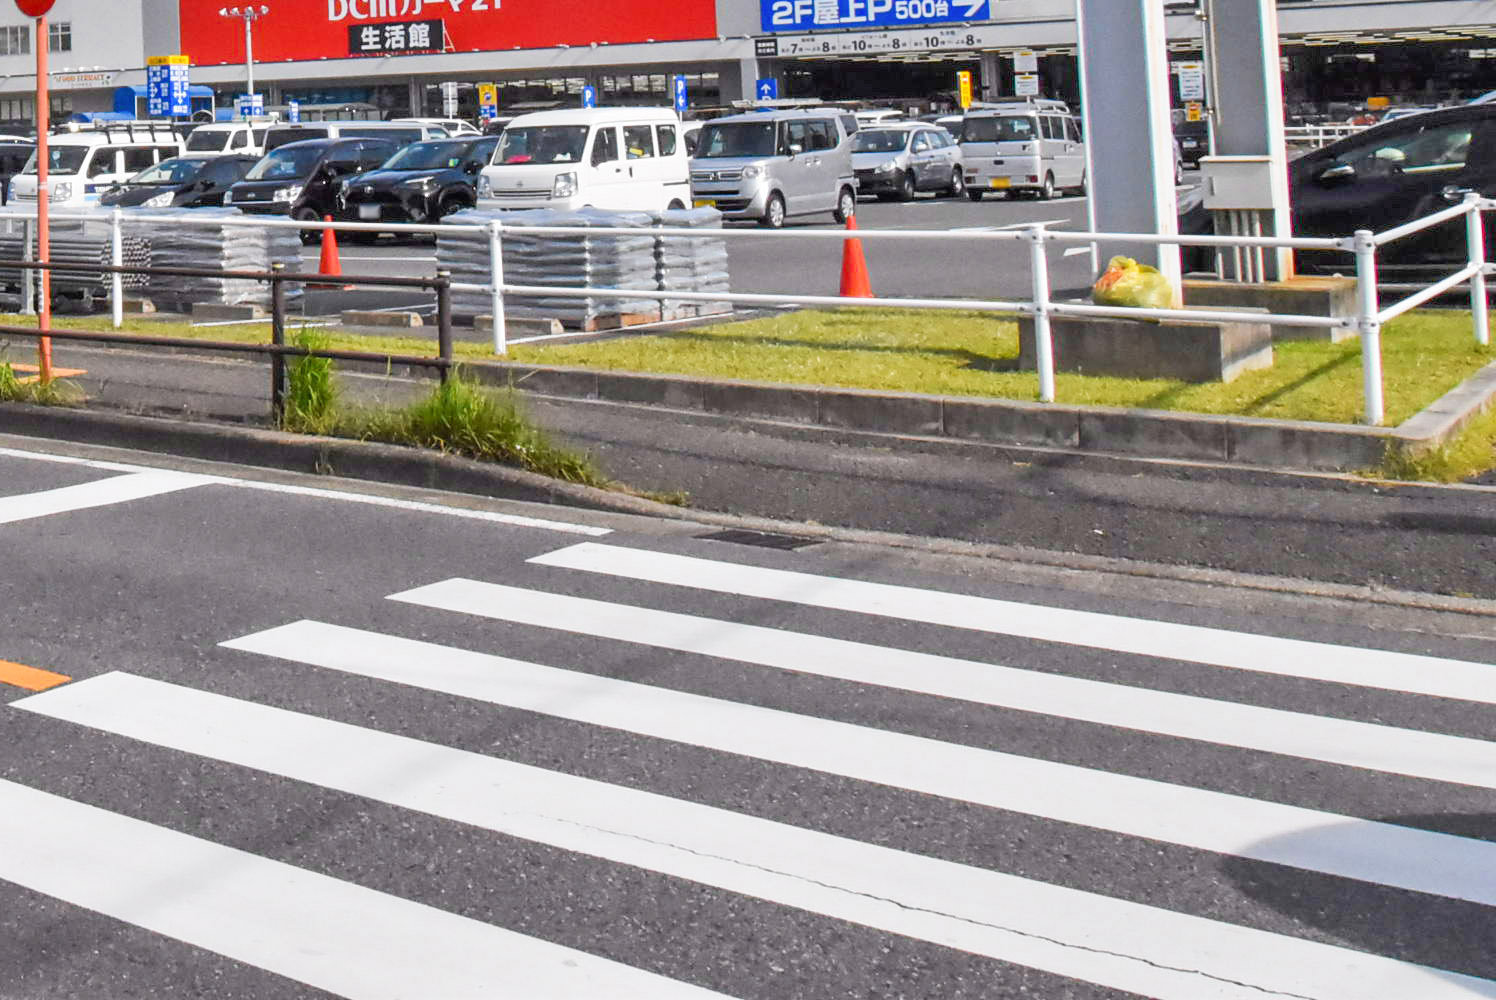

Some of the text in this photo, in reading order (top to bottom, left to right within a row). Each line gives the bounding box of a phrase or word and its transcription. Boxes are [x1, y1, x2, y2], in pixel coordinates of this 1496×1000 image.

[895, 0, 949, 20] 500台
[360, 22, 430, 50] 生活館
